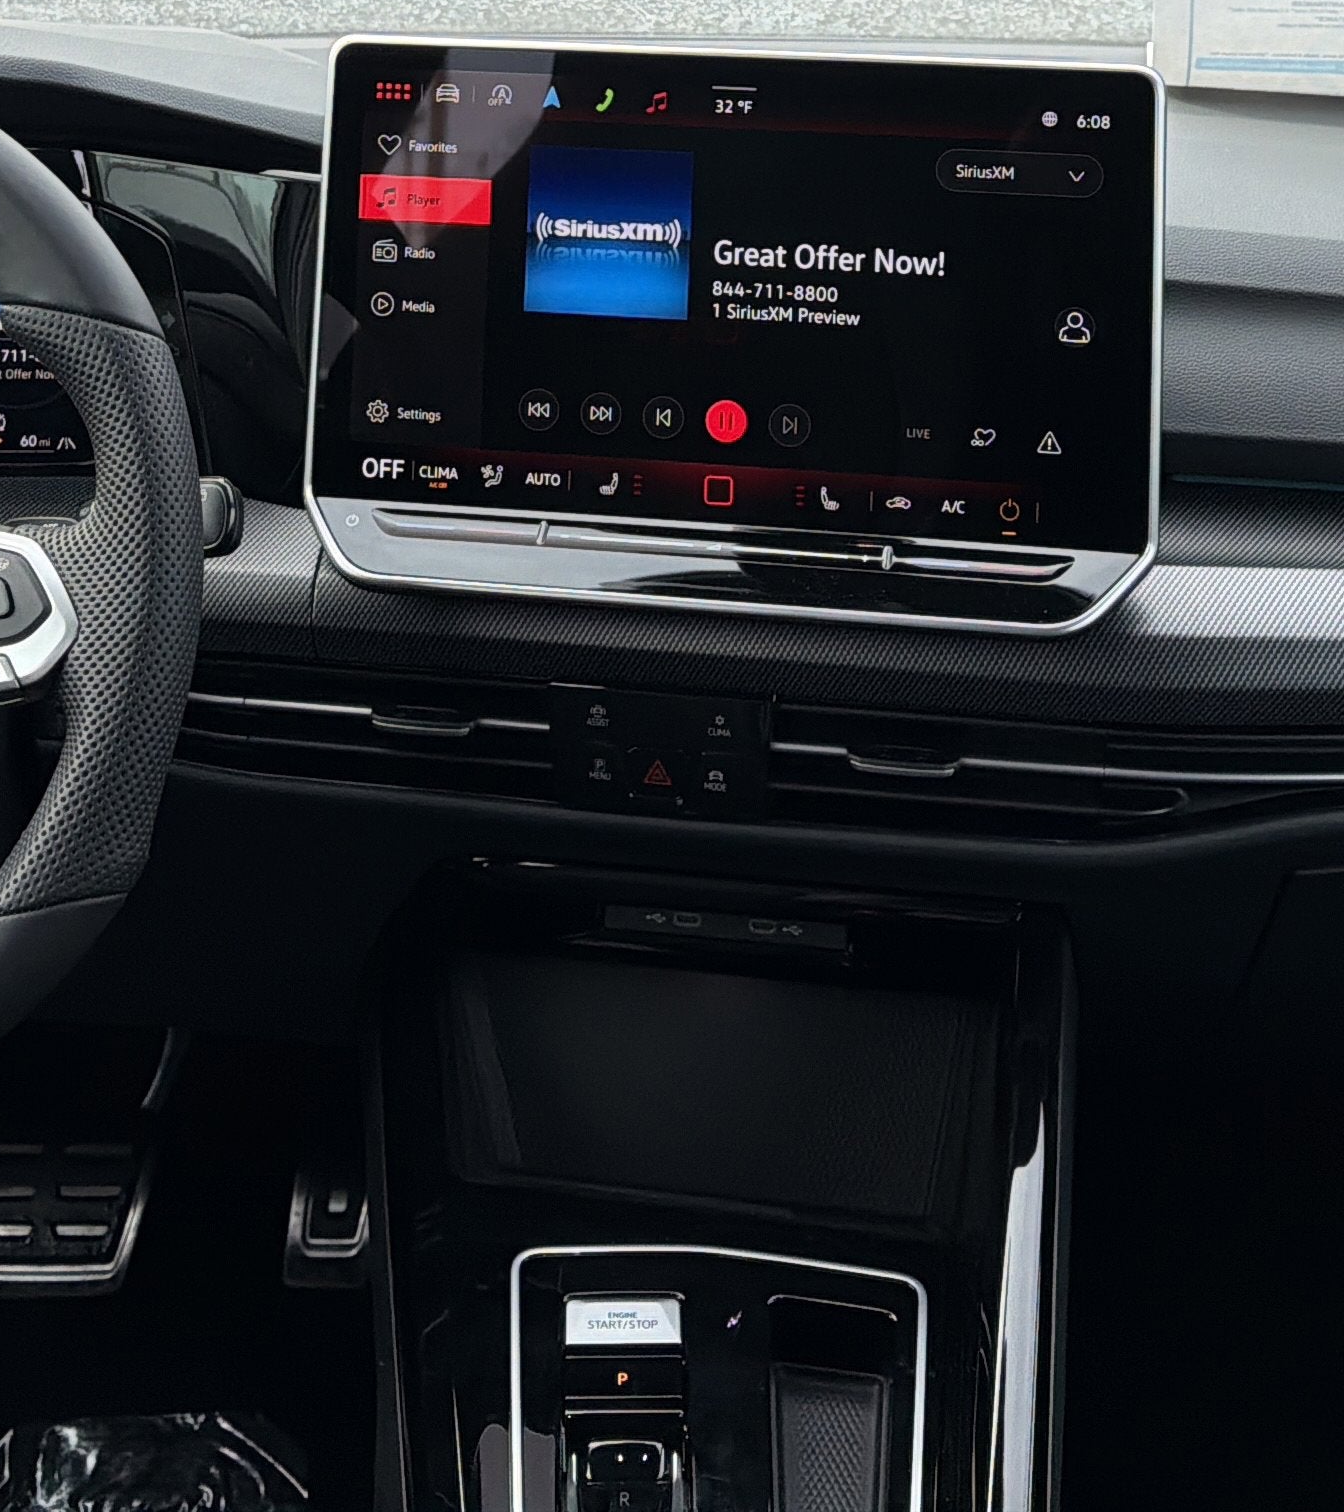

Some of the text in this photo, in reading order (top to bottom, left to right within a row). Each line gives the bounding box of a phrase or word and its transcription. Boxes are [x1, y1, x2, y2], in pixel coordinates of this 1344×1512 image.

[715, 99, 734, 114] 32
[1076, 114, 1111, 130] 6:08
[409, 140, 457, 154] Favorites
[956, 164, 1015, 180] SiriusXM
[406, 193, 441, 207] Player
[404, 247, 435, 260] Radio
[714, 239, 946, 277] Great Offer Now!
[712, 280, 838, 303] 844-711-8800
[401, 300, 435, 313] Media
[713, 303, 861, 327] 1 SiriusXM Preview
[5, 368, 32, 380] Offer
[397, 407, 441, 423] Settings
[20, 434, 51, 448] 60 mi
[906, 428, 931, 440] LIVE
[362, 457, 406, 480] OFF
[419, 465, 459, 480] CLIMA
[525, 472, 561, 487] AUTO
[941, 500, 966, 515] A/C
[586, 717, 609, 728] ASSIST
[707, 727, 731, 738] CLIMA
[589, 771, 611, 781] MENU
[704, 782, 727, 793] MODE
[608, 1311, 638, 1320] ENGINE
[587, 1319, 659, 1331] START/STOP
[616, 1372, 629, 1386] P
[618, 1491, 630, 1507] R
